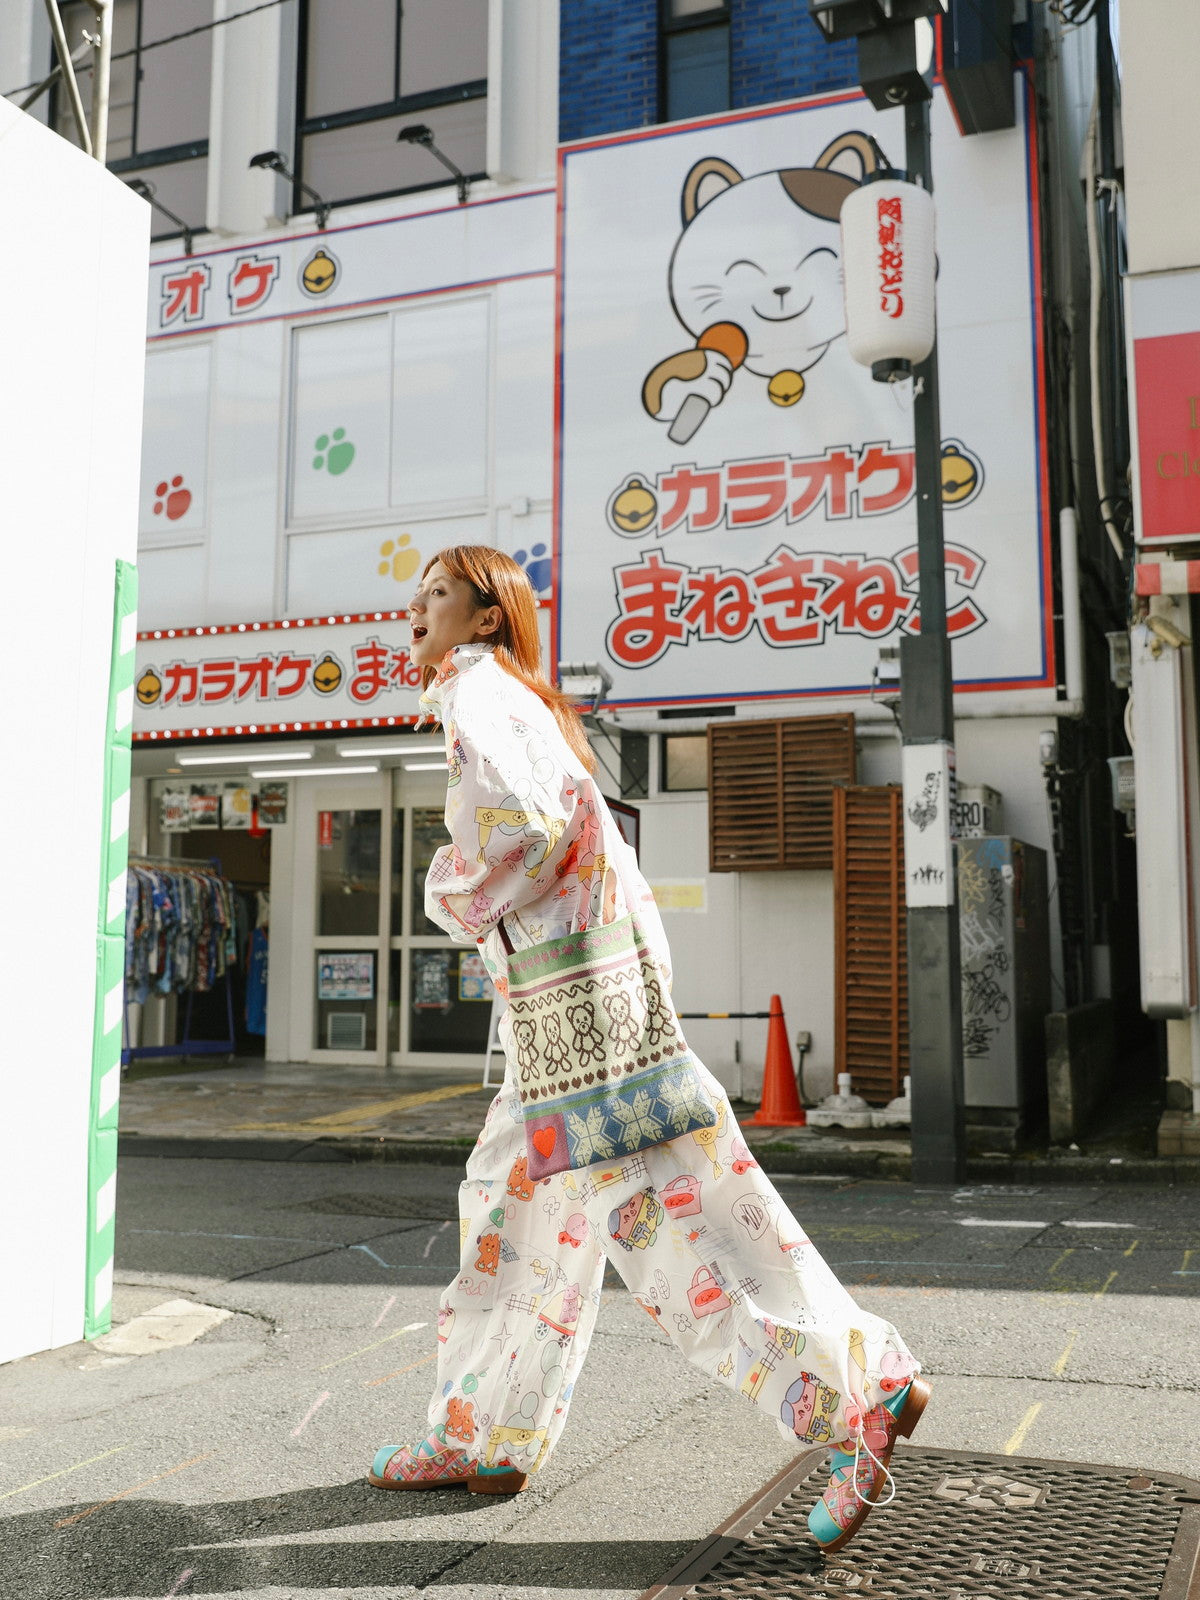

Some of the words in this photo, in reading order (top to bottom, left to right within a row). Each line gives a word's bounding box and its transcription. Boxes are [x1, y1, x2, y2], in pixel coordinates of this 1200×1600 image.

[657, 442, 918, 537] カラオケ
[606, 545, 986, 668] まねきねこ
[162, 653, 315, 706] カラオケ
